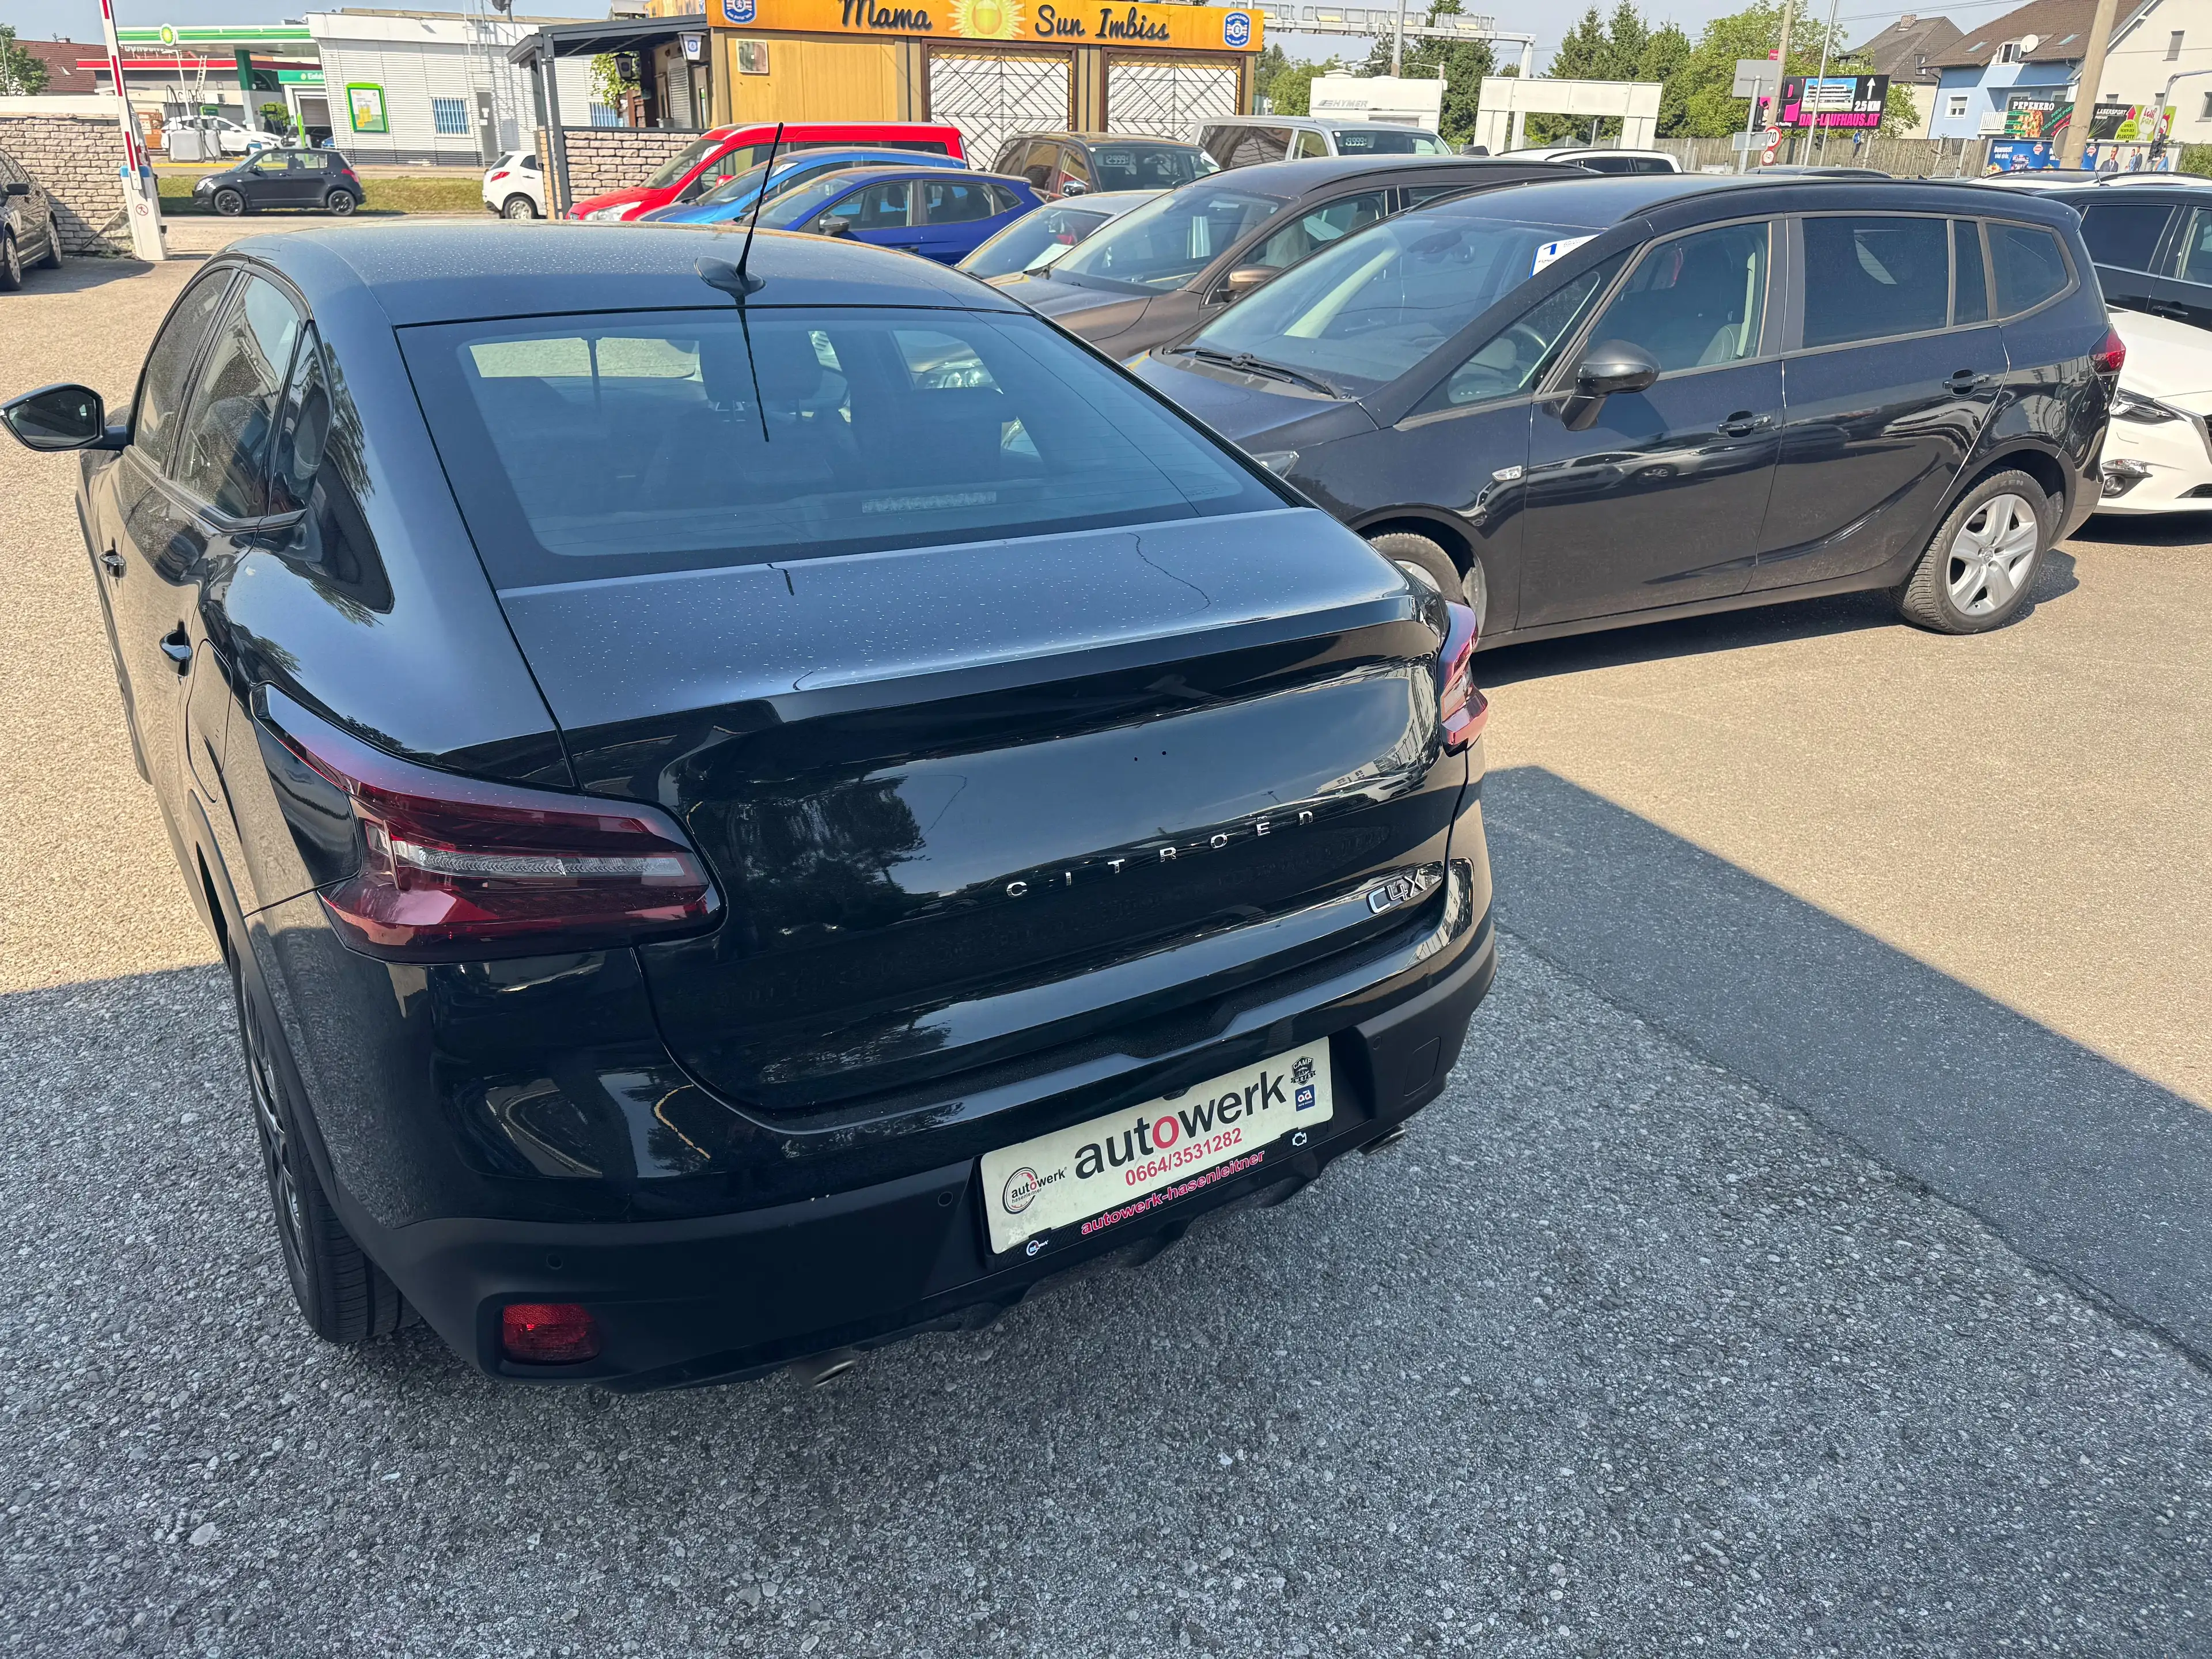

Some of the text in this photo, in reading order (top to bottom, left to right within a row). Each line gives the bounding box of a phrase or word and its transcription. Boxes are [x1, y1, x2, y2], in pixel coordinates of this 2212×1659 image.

[842, 0, 1170, 40] Mama Sun Imbiss
[1333, 99, 1368, 107] HYMER
[1868, 101, 1881, 112] KM
[2012, 101, 2055, 111] PEPENERO
[1768, 132, 1777, 143] 70
[1543, 243, 1557, 255] 1
[1293, 1058, 1312, 1069] CAMP
[1295, 1073, 1312, 1082] werk
[1075, 1071, 1286, 1179] autowerk
[1125, 1127, 1242, 1186] 0664/3531282
[1012, 1188, 1042, 1203] hasenleitner
[1081, 1150, 1265, 1235] autowerk-hasenleitner
